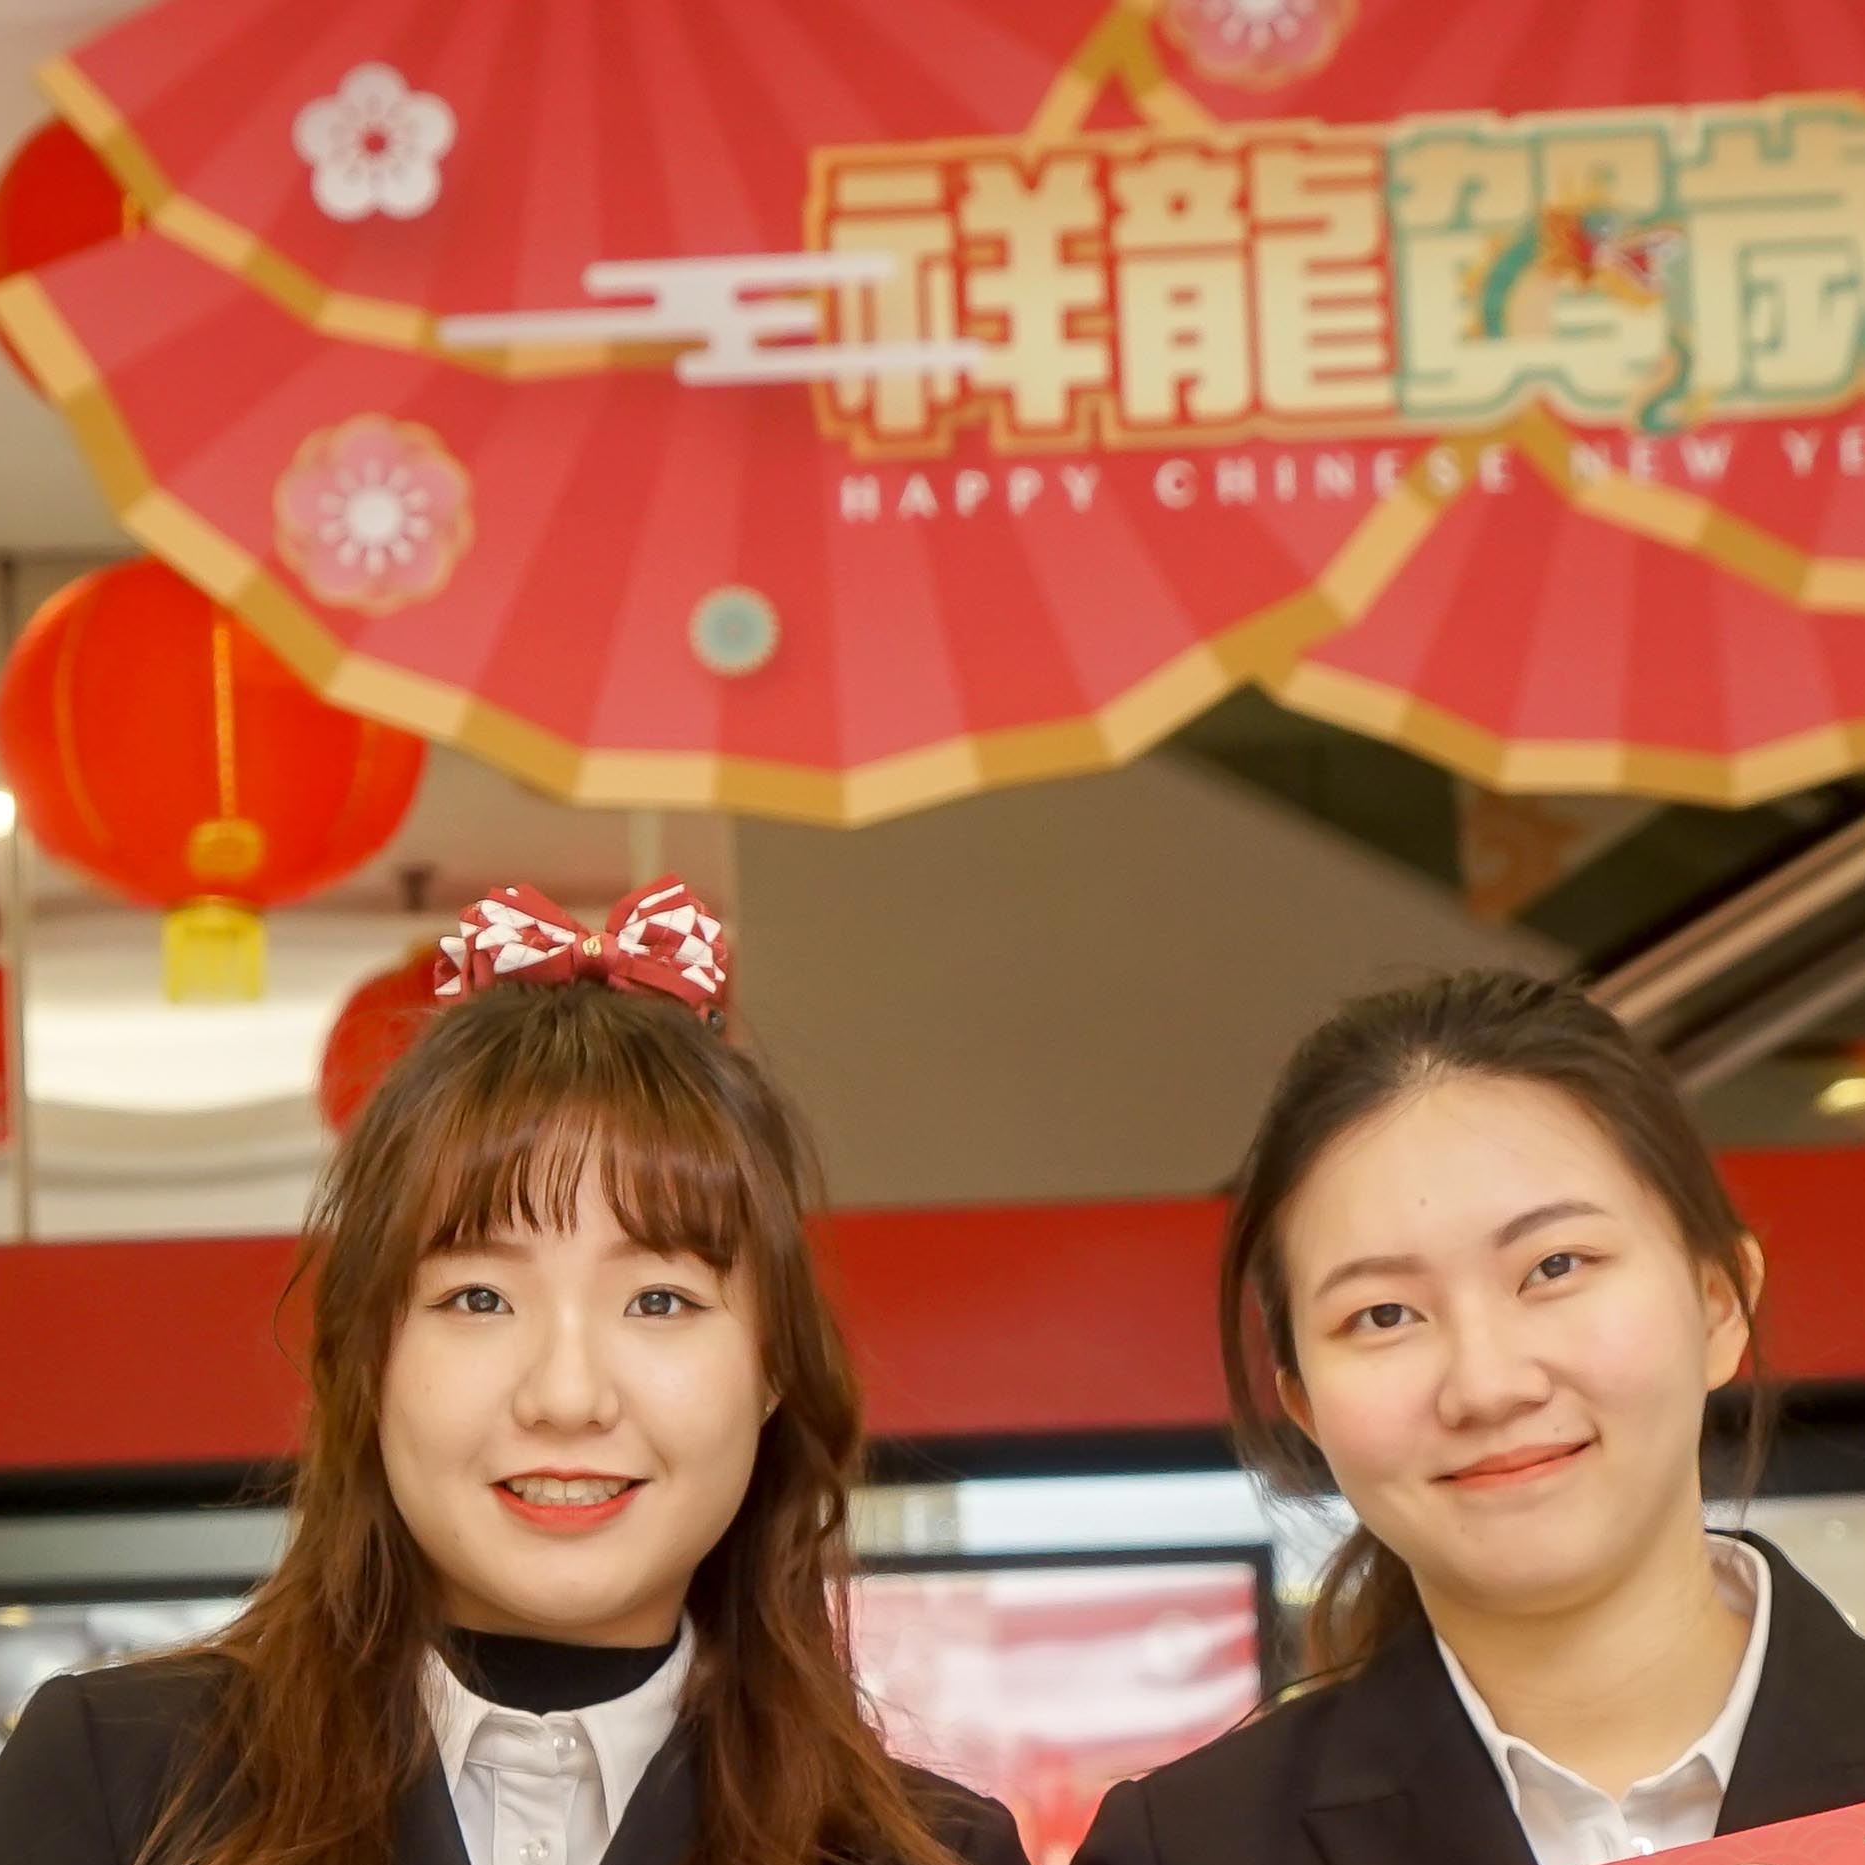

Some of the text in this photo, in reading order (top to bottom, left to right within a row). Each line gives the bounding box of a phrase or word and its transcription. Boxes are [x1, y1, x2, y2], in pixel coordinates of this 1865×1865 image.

[838, 466, 1103, 522] HAPPY
[1153, 452, 1519, 512] CHINESE
[1567, 434, 1735, 489] NEW
